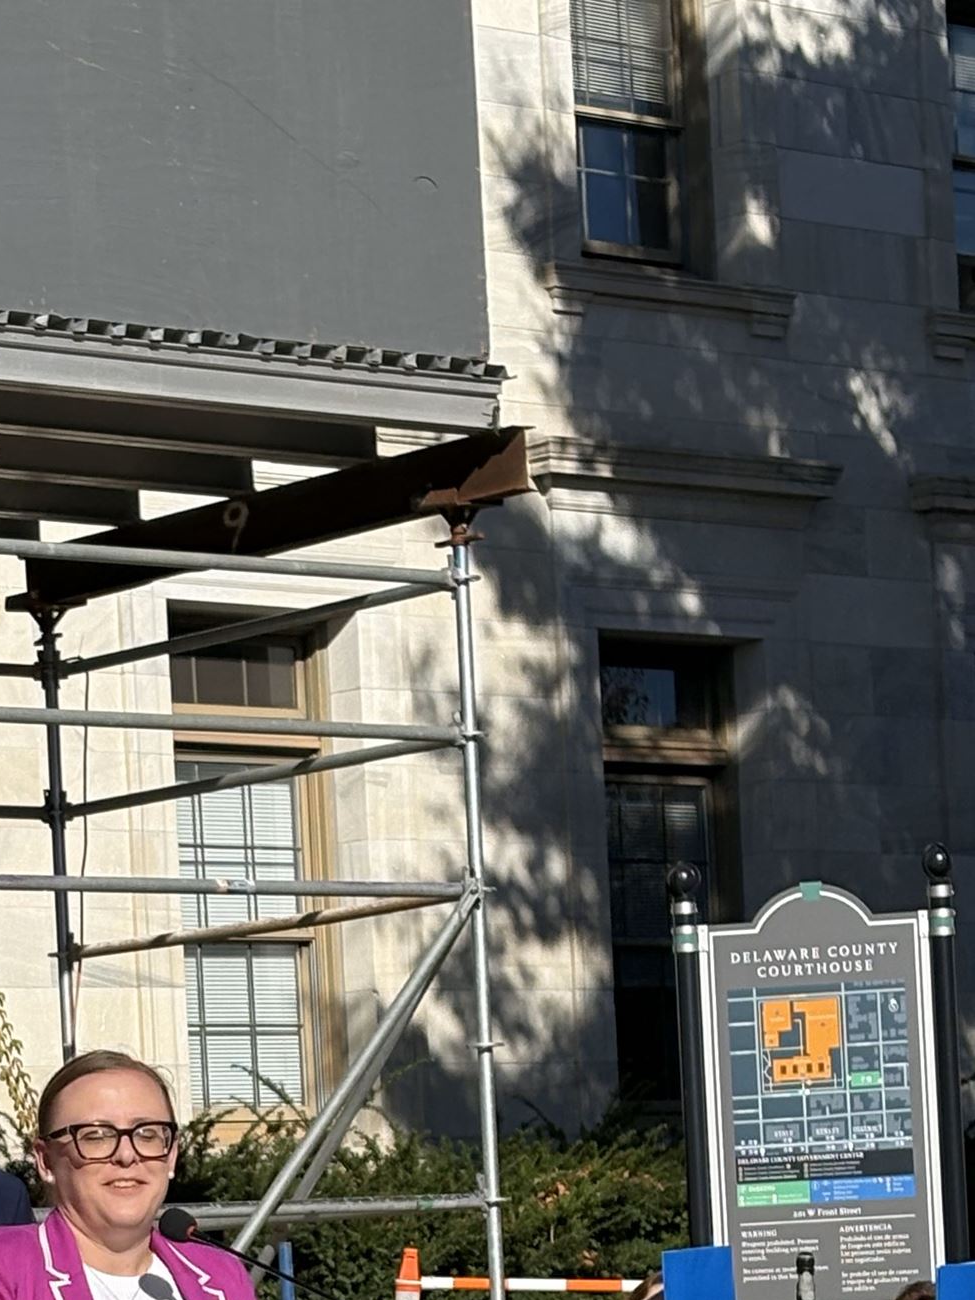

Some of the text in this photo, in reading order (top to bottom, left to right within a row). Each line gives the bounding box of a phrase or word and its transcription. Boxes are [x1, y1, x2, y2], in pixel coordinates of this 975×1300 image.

[730, 941, 898, 964] DELAWARE COUNTY
[756, 959, 873, 978] COURTHOUSE
[737, 1151, 864, 1165] DELAWARE COUNTY GOVERNMENT CENTER
[807, 1208, 817, 1217] W
[817, 1207, 839, 1217] Front
[839, 1206, 862, 1216] Street
[741, 1228, 777, 1239] WARNING
[839, 1223, 893, 1233] ADVERTENCIA
